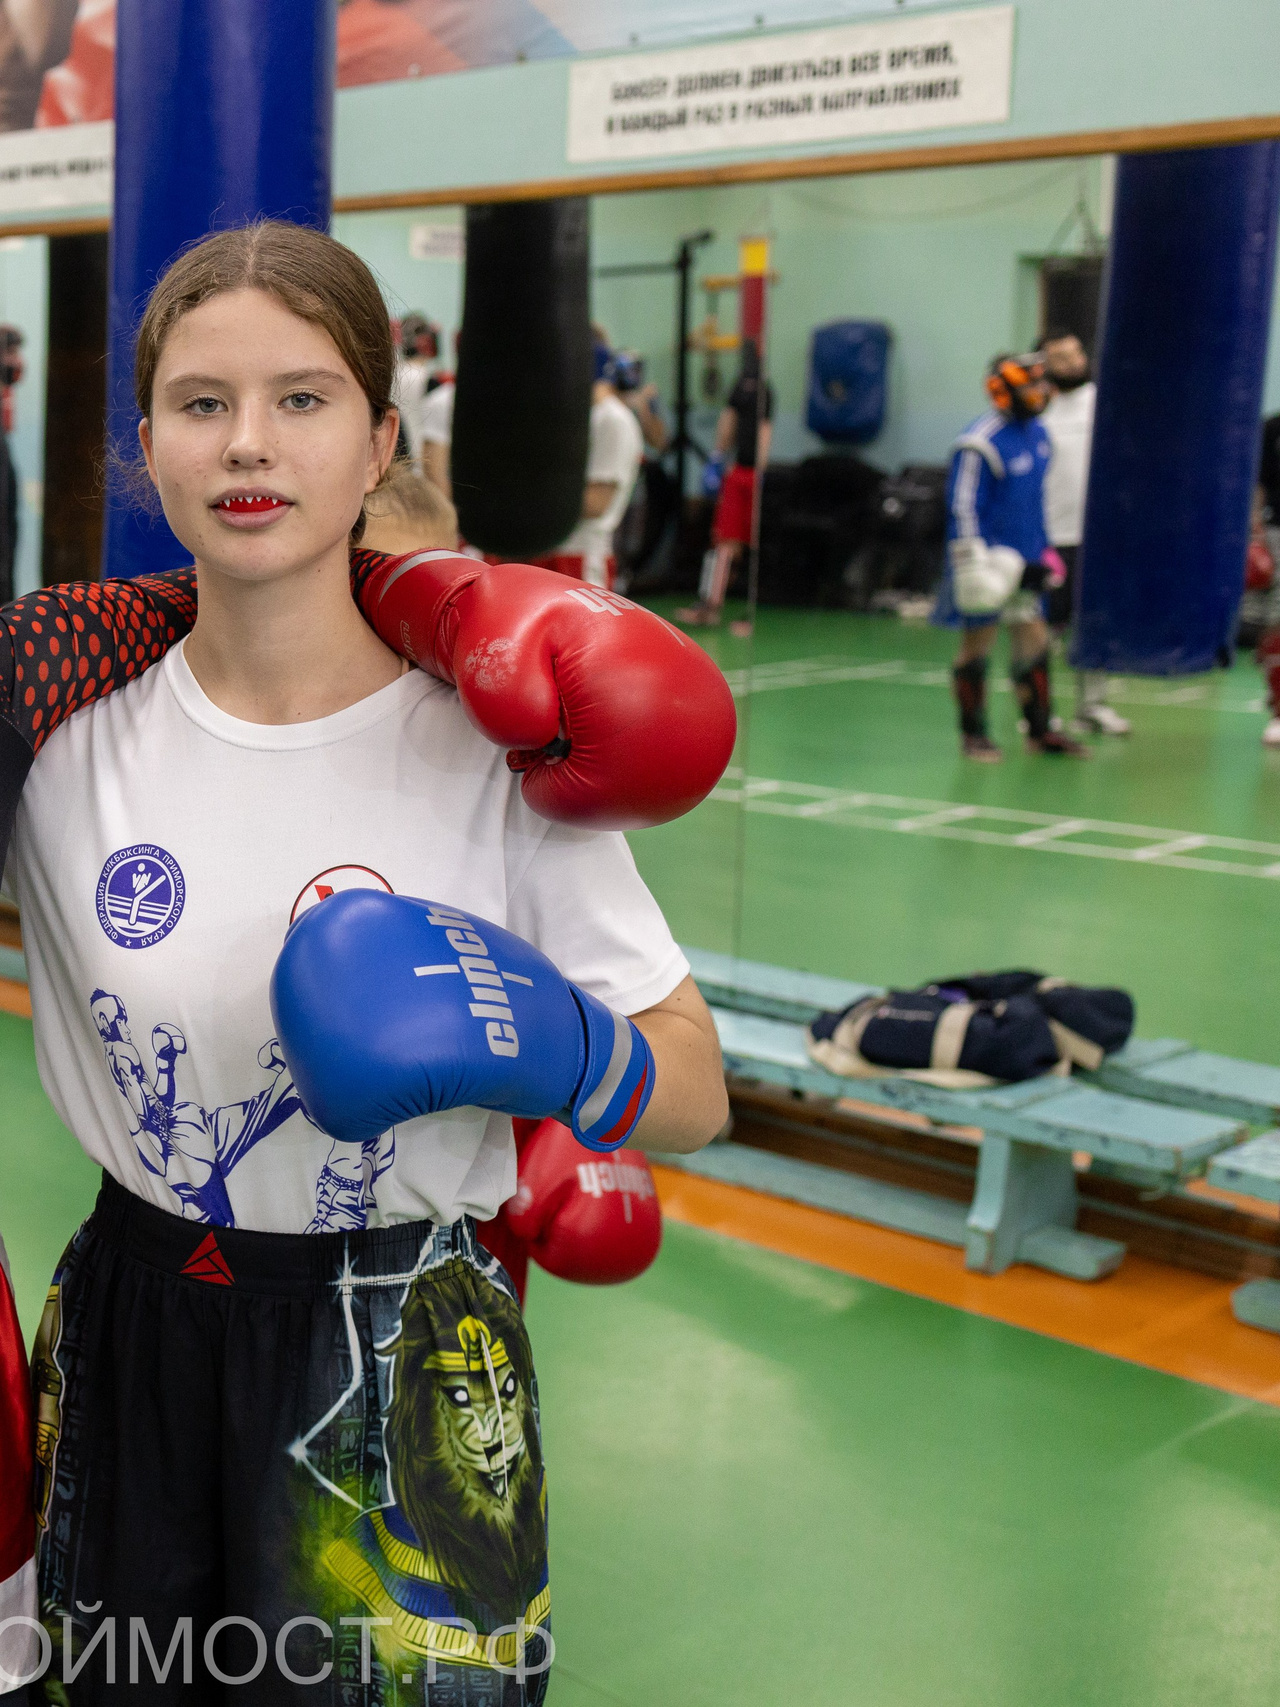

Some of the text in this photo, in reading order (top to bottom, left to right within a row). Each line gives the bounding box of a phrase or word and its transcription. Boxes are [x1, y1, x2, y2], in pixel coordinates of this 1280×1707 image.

[97, 846, 184, 946] ФЕДЕРАЦИЯ КИКБОКСИНГА ПРИМОРСКОГО КРАЯ
[425, 906, 520, 1059] clinch
